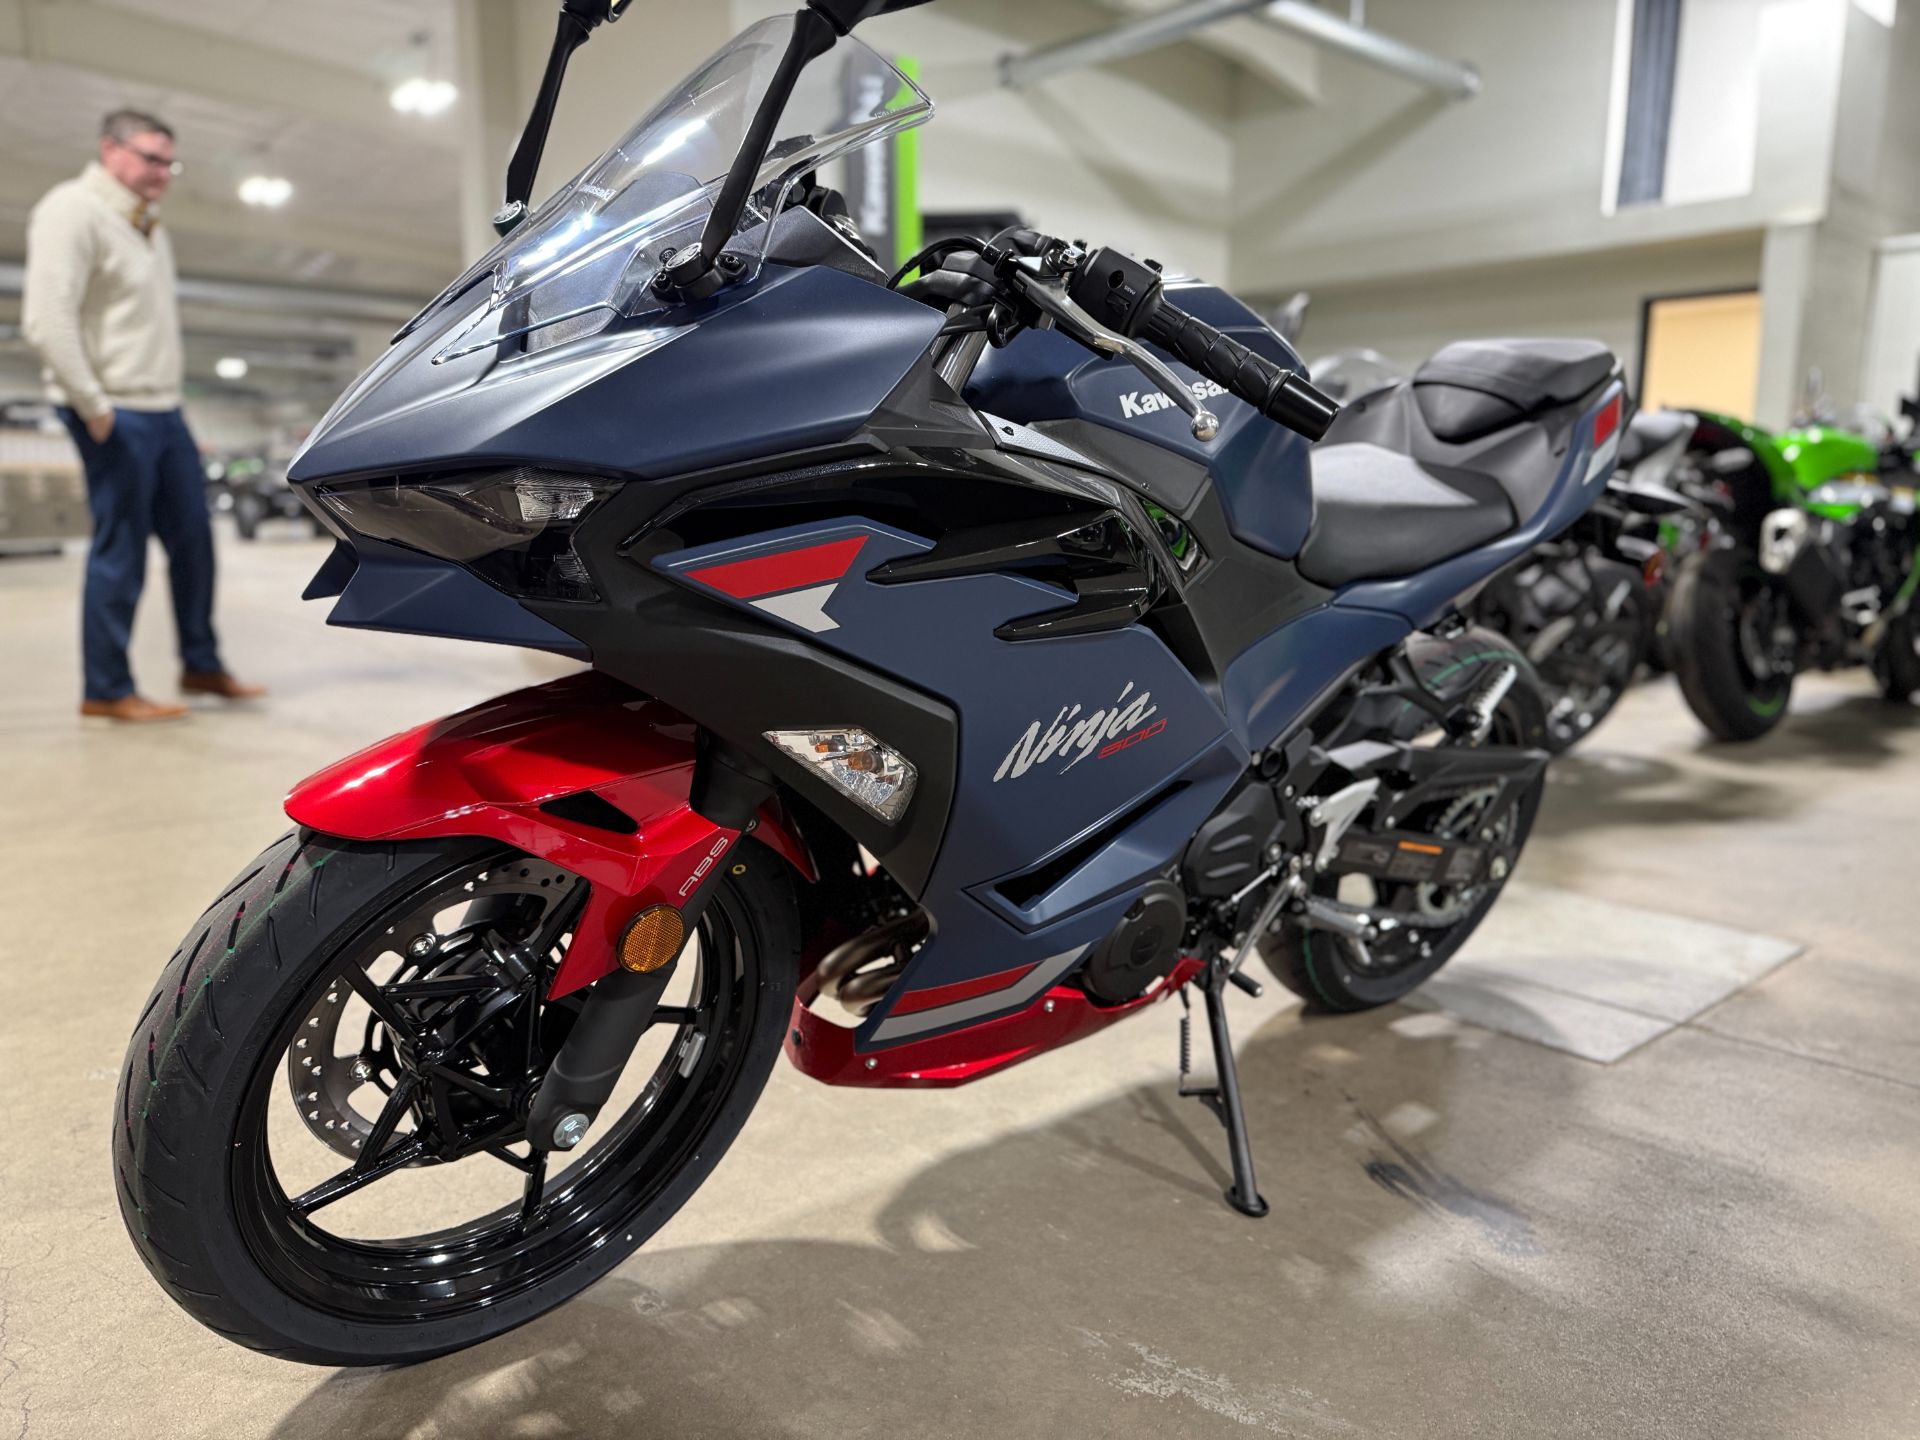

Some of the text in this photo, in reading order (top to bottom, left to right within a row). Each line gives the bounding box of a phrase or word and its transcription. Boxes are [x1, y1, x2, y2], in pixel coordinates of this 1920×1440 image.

[859, 74, 887, 235] Kawaki
[1119, 379, 1230, 419] Kawsa
[993, 681, 1157, 783] Ninja
[1097, 718, 1168, 760] 500
[678, 837, 729, 897] ABS
